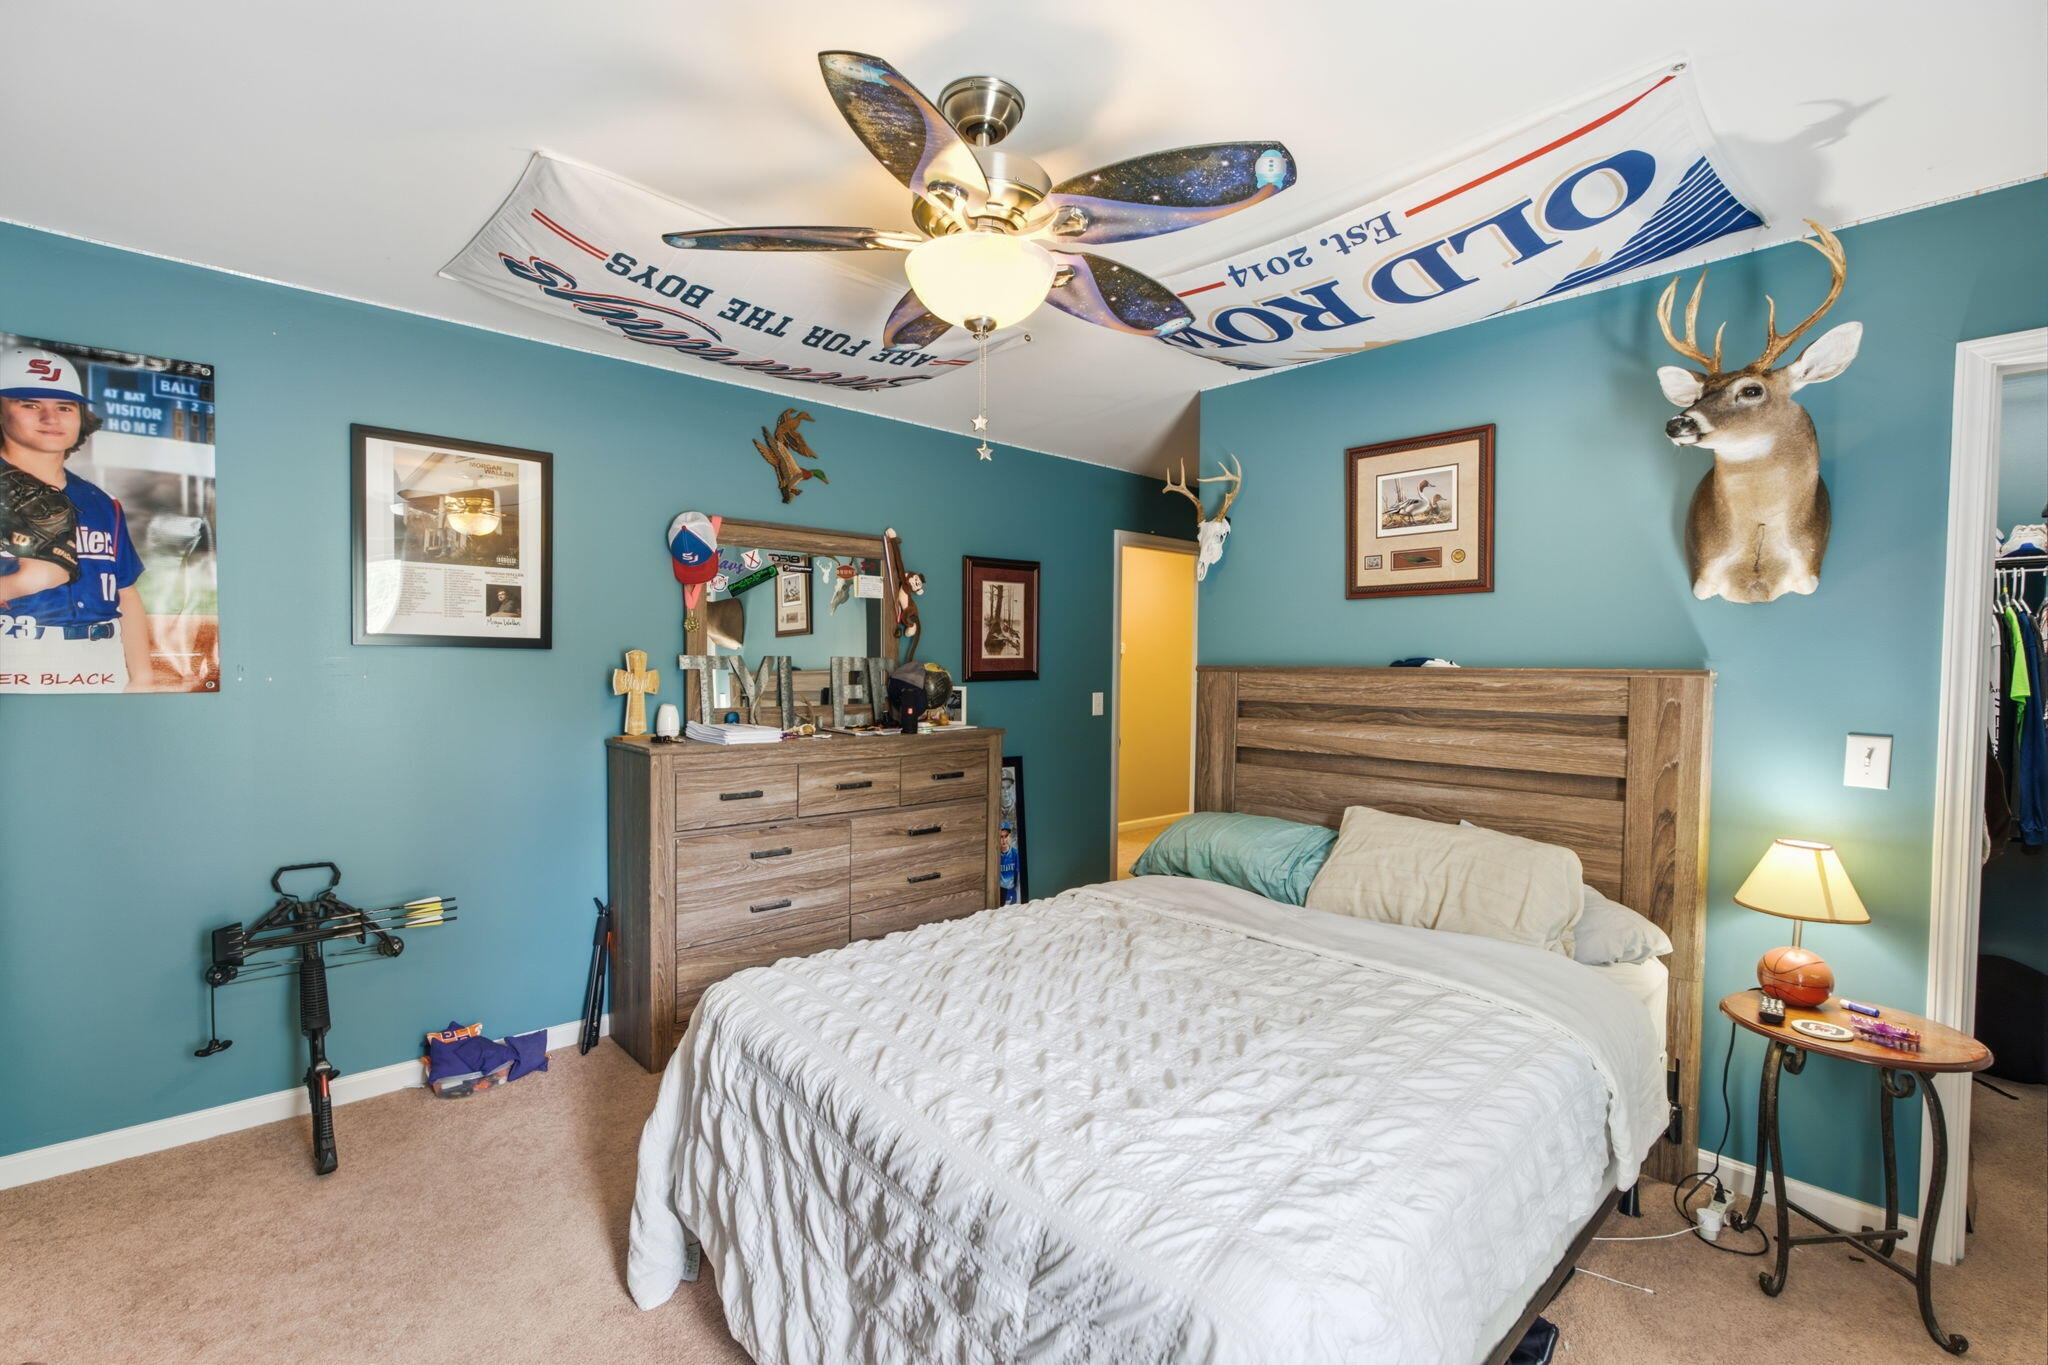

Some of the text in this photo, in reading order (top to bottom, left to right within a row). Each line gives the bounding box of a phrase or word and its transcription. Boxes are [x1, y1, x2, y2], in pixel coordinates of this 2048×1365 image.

[1158, 149, 1656, 349] OLD ROW
[1227, 211, 1402, 288] Est. 2014
[604, 252, 938, 368] ARE FOR THE BOYS
[25, 359, 62, 382] SJ
[103, 388, 146, 402] AT BAT
[160, 379, 198, 396] BALL
[105, 402, 162, 420] VISITOR
[108, 418, 158, 435] HOME
[100, 573, 117, 601] 11
[40, 673, 116, 686] BLACK
